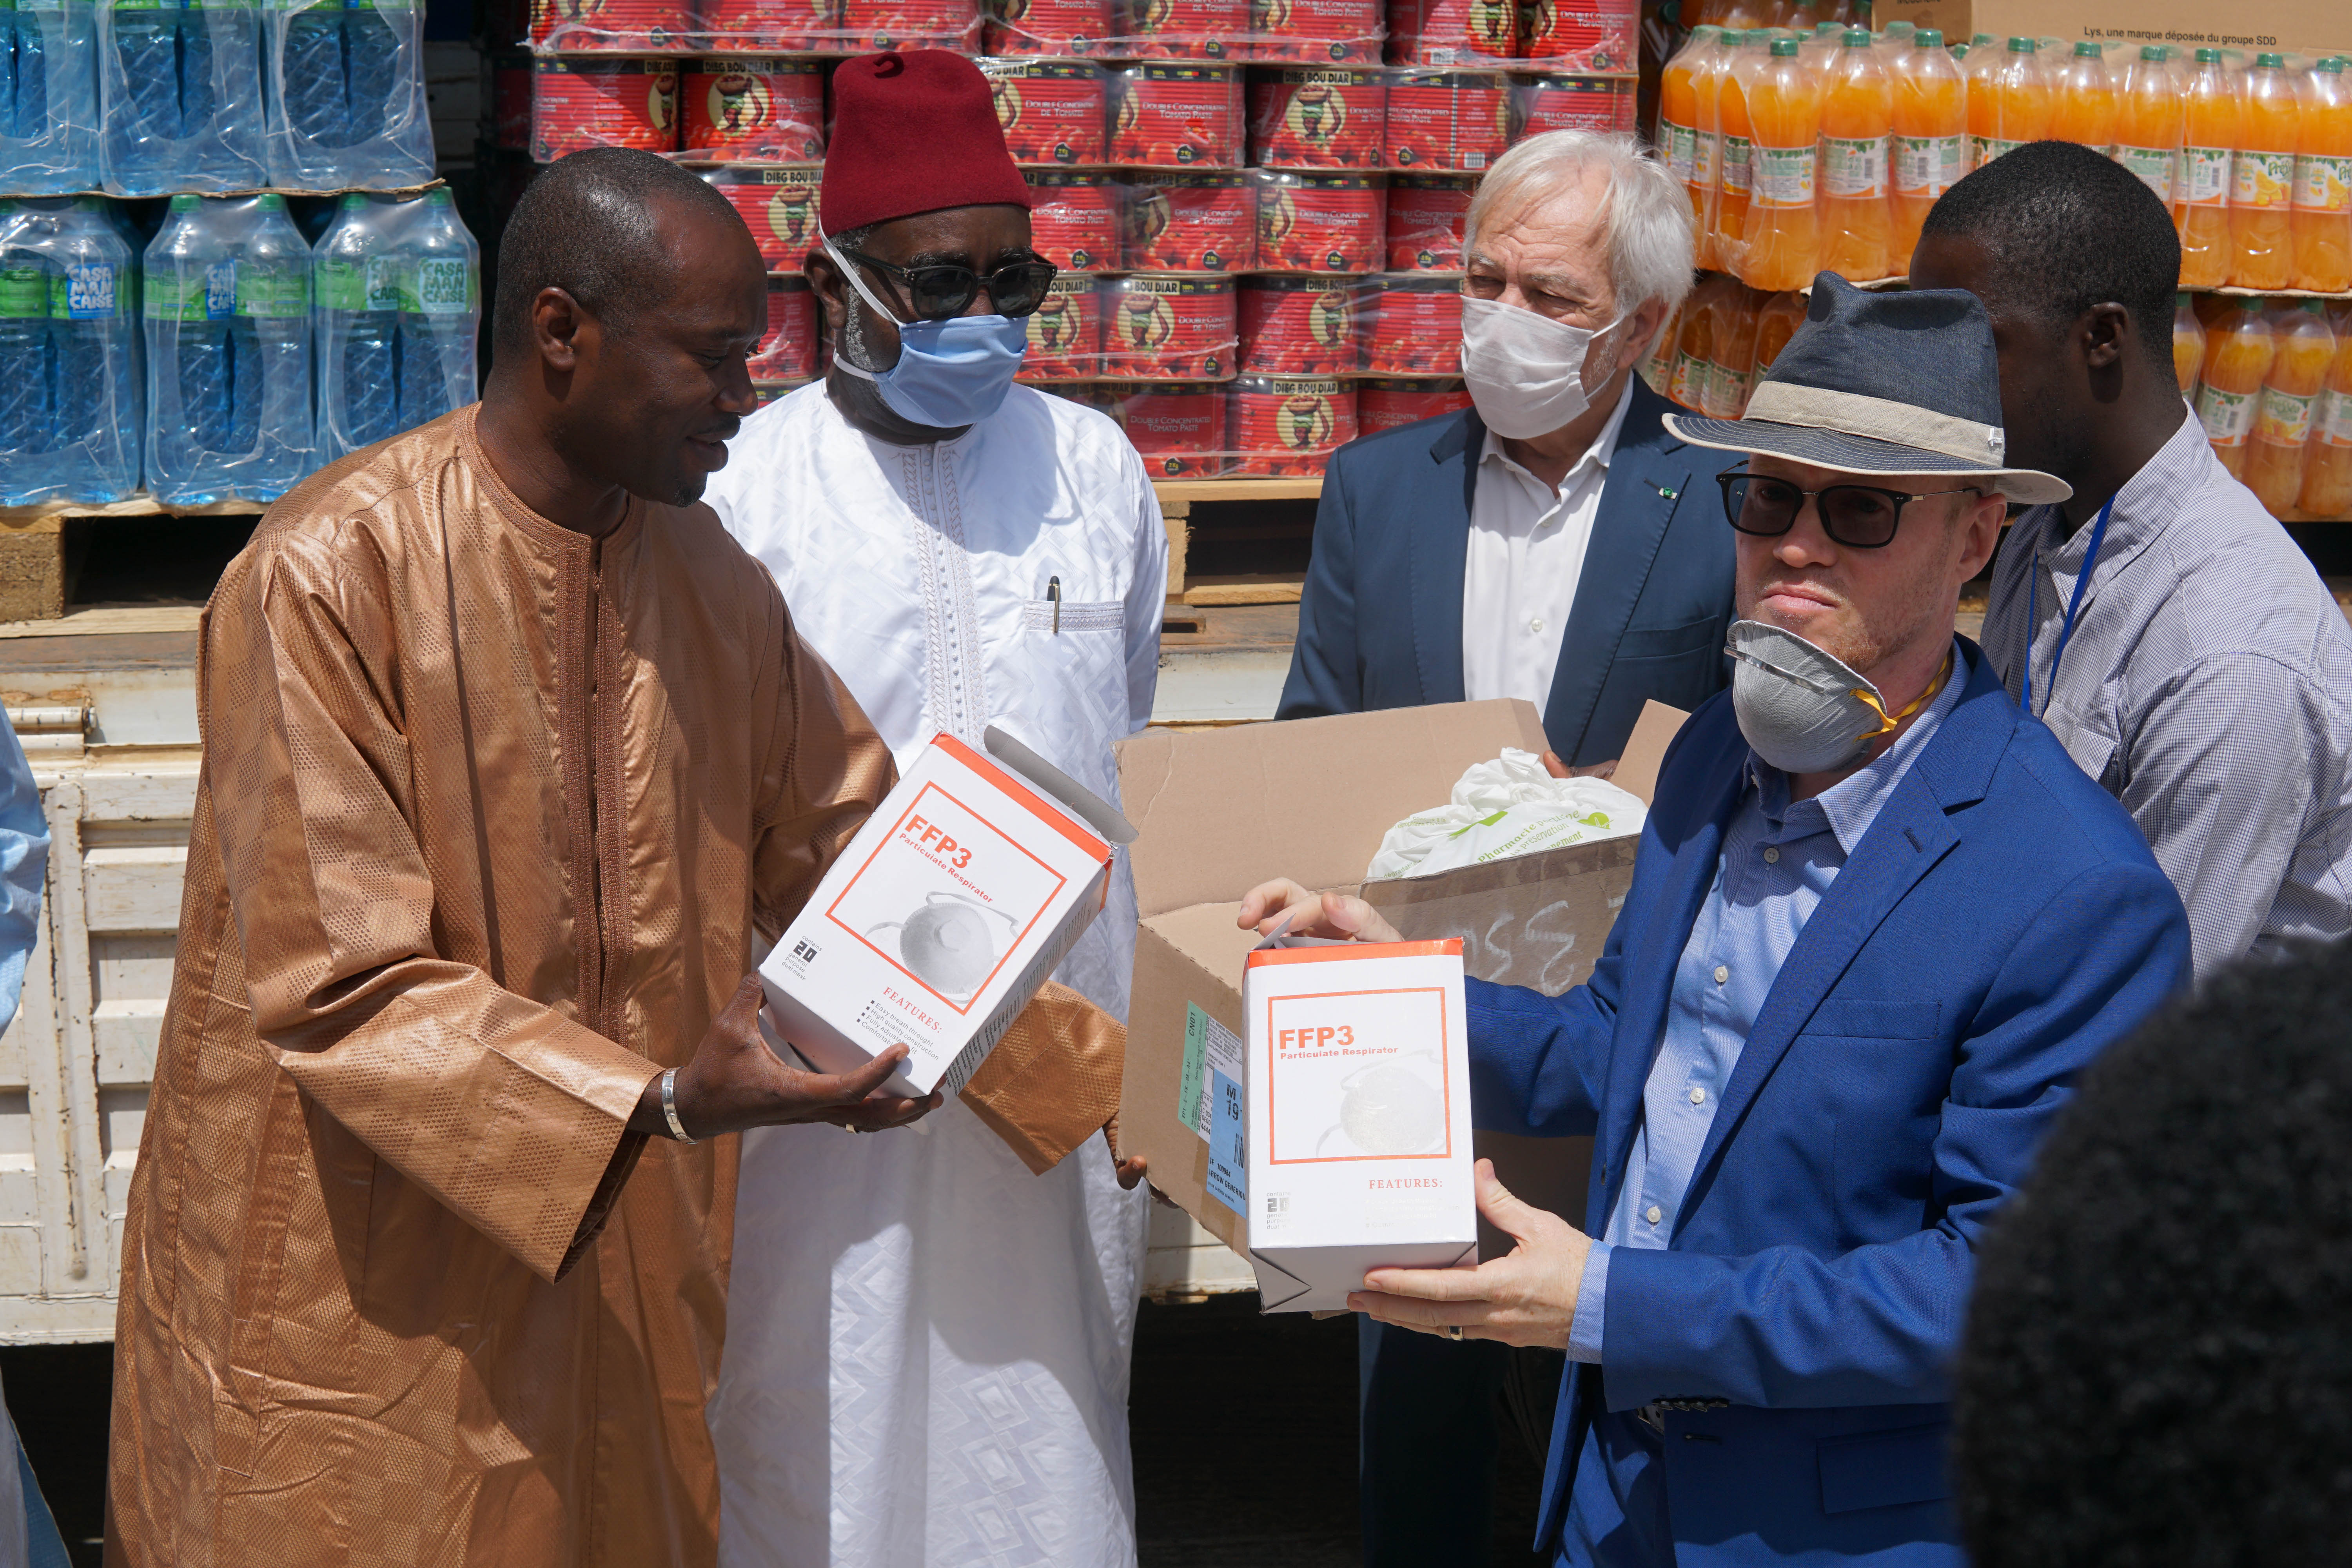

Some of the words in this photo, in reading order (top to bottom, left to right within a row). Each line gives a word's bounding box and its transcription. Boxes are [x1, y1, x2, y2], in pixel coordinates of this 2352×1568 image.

[2084, 26, 2104, 37] Lys,
[2107, 29, 2124, 37] une
[2127, 31, 2162, 41] marque
[2165, 30, 2205, 43] déposée
[2208, 33, 2219, 42] du
[2222, 35, 2254, 45] groupe
[2256, 35, 2276, 45] SDD
[1328, 73, 1349, 83] DIAR
[766, 172, 787, 182] DIEG
[790, 172, 808, 182] BOU
[1066, 281, 1083, 292] DIAR
[1155, 282, 1177, 292] DIAR
[1276, 383, 1296, 393] DIEG
[1298, 383, 1316, 393] BOU
[1319, 383, 1337, 394] DIAR
[904, 814, 972, 869] FFP3
[1477, 824, 1537, 863] Pharmacie
[1520, 822, 1570, 850] préservation
[947, 867, 993, 903] Respirator
[793, 940, 818, 963] 20
[802, 935, 822, 952] contains
[785, 956, 805, 973] purpose
[788, 952, 808, 967] general
[793, 969, 806, 981] mask
[882, 986, 942, 1033] FEATURES:
[866, 1015, 881, 1028] Fully
[875, 1003, 890, 1016] Easy
[890, 1013, 909, 1030] breath
[909, 1027, 934, 1047] throught
[861, 1021, 894, 1046] Comfortabl
[870, 1009, 884, 1022] High
[884, 1019, 904, 1036] quality
[904, 1033, 939, 1060] construction
[1279, 1025, 1354, 1050] FFP3
[1342, 1047, 1398, 1056] Respirator
[1227, 1083, 1237, 1102] M
[1217, 1163, 1231, 1178] 100984
[1368, 1178, 1443, 1189] FEATURES:
